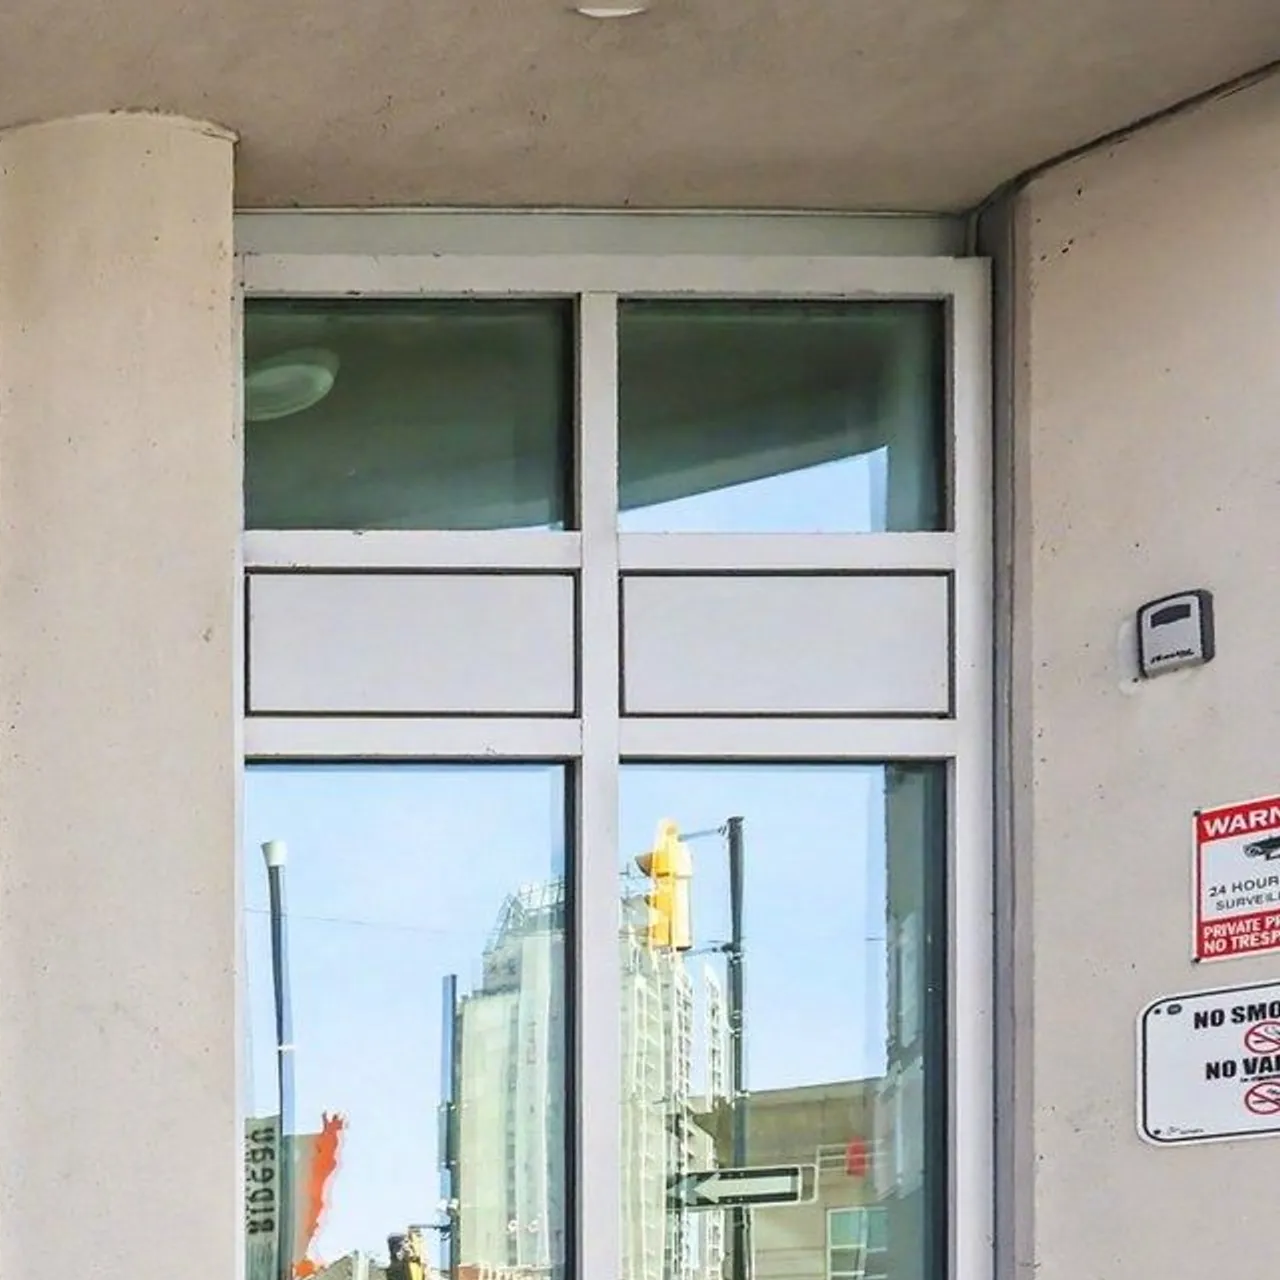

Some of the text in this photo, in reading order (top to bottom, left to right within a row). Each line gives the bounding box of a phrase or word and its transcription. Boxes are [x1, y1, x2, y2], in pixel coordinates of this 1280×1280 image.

[1209, 886, 1226, 898] 24
[1204, 918, 1261, 939] PRIVATE
[1204, 930, 1280, 954] NO TRESP
[1194, 1009, 1224, 1030] NO
[1231, 1001, 1280, 1024] SMO
[1206, 1060, 1237, 1080] NO
